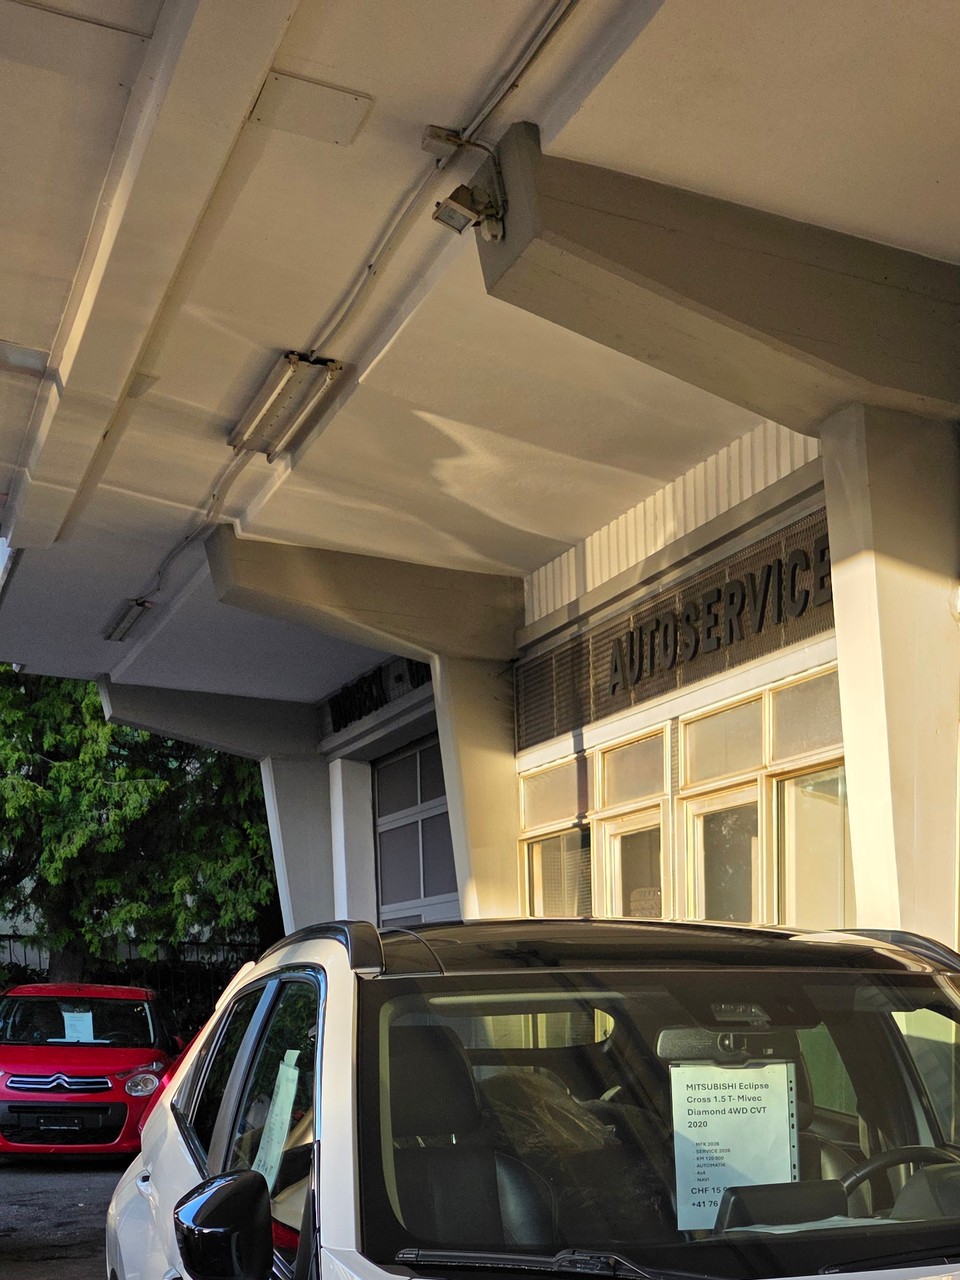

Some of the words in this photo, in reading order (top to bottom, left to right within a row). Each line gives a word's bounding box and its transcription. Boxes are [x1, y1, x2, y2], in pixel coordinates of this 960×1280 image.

[608, 533, 833, 695] AUTOSERVICE
[686, 1083, 737, 1091] MITSUBISHI
[739, 1082, 769, 1091] Eclipse
[714, 1095, 726, 1103] 1.5
[687, 1108, 726, 1116] Diamond
[728, 1107, 748, 1115] 4WD
[750, 1106, 767, 1114] CVT
